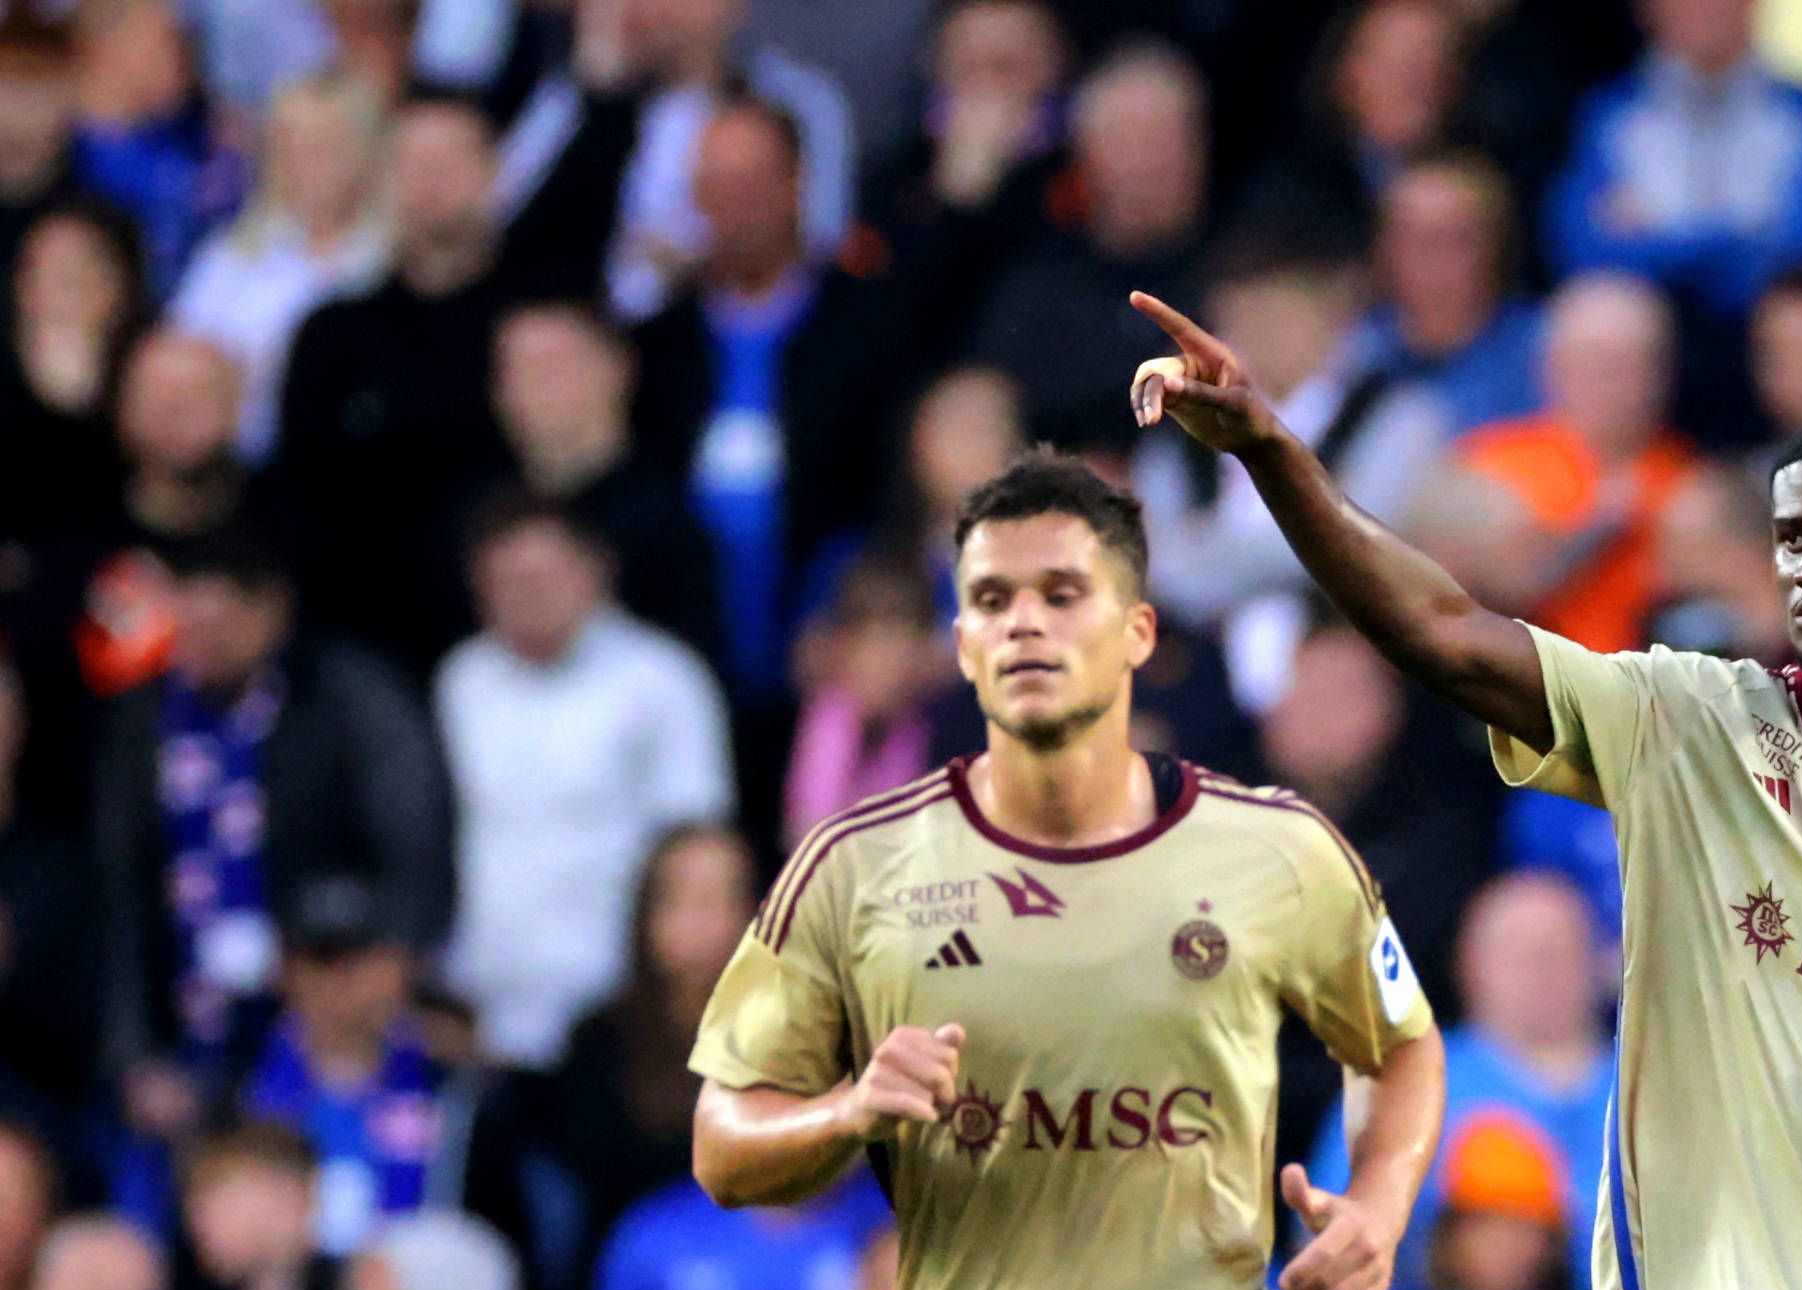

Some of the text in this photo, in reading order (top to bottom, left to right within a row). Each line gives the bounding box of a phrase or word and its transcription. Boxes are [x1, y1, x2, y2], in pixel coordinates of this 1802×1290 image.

[892, 879, 980, 906] CREDIT
[906, 904, 981, 928] SUISSE
[1022, 1087, 1212, 1150] MSC
